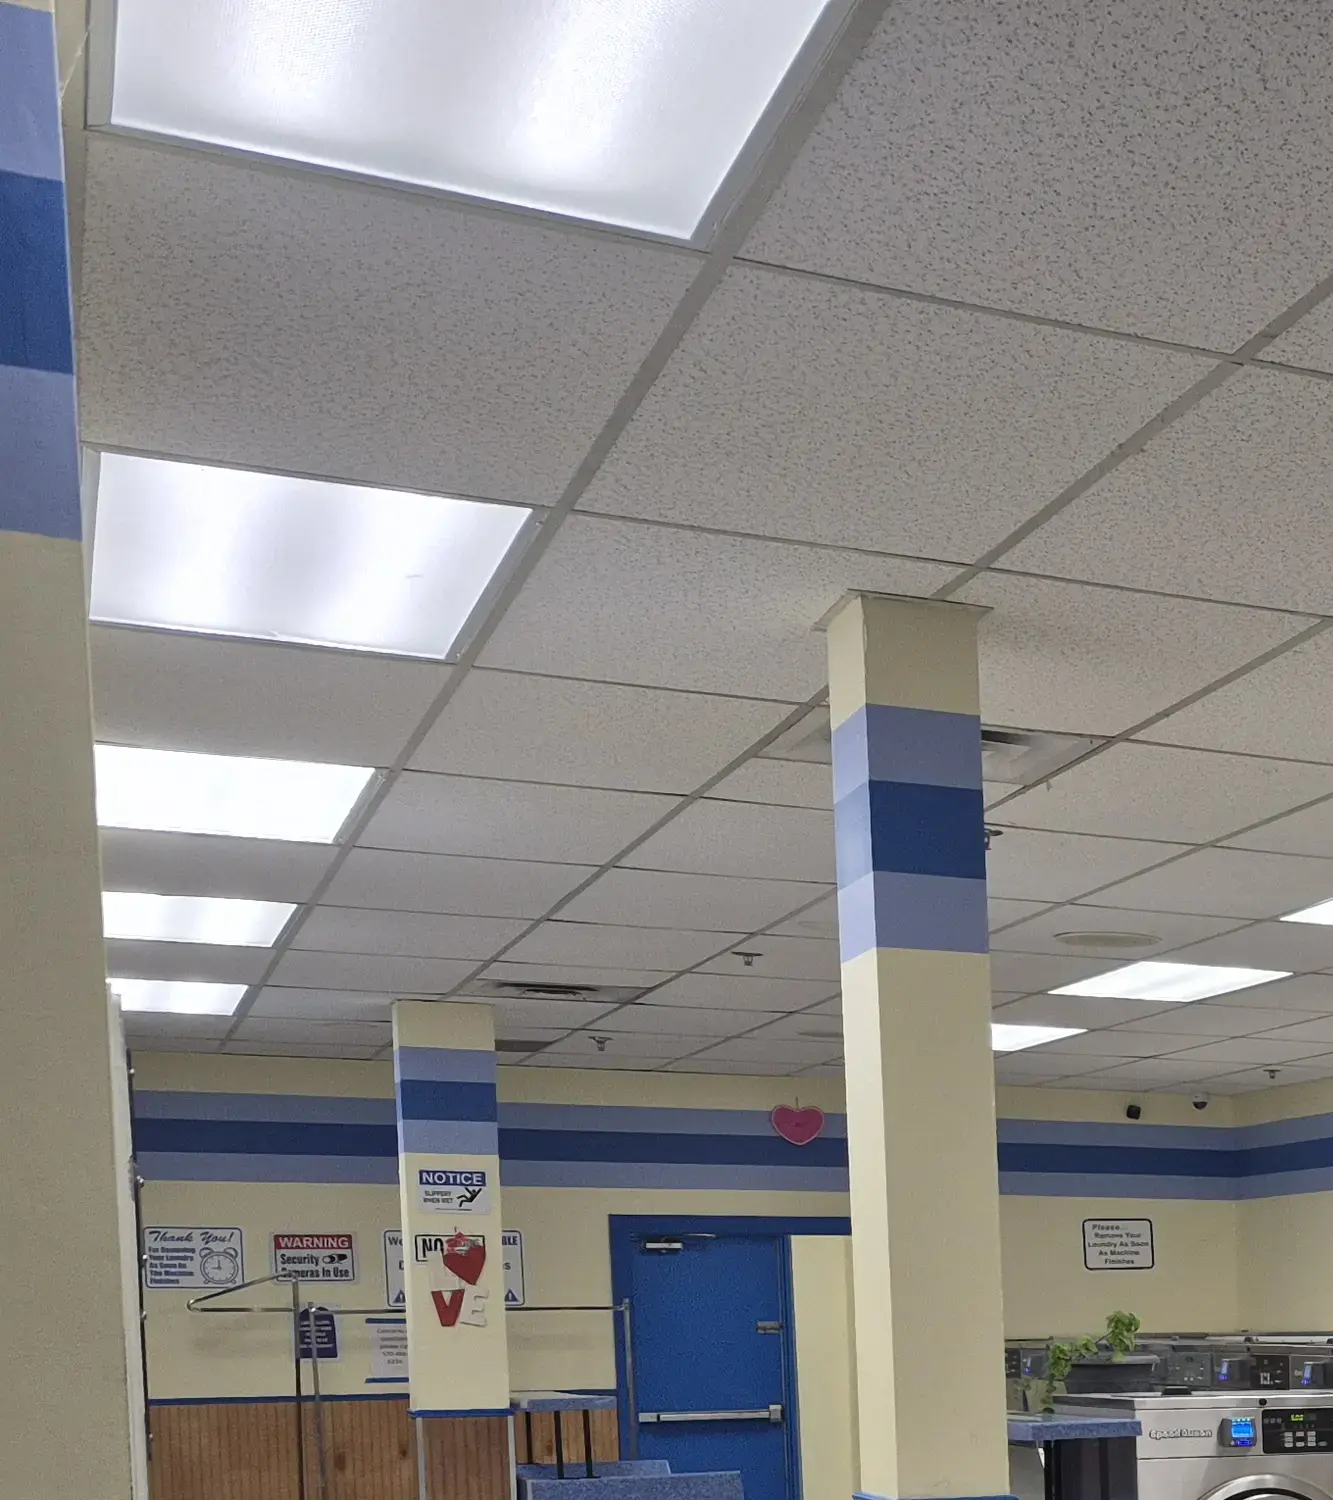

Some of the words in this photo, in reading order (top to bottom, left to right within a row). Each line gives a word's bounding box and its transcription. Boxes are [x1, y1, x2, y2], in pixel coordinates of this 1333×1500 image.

[421, 1172, 483, 1185] NOTICE
[149, 1230, 193, 1242] Thank
[200, 1231, 234, 1245] You!
[279, 1237, 348, 1248] WARNING
[280, 1253, 319, 1266] Security
[322, 1267, 331, 1278] In
[333, 1267, 349, 1278] Use
